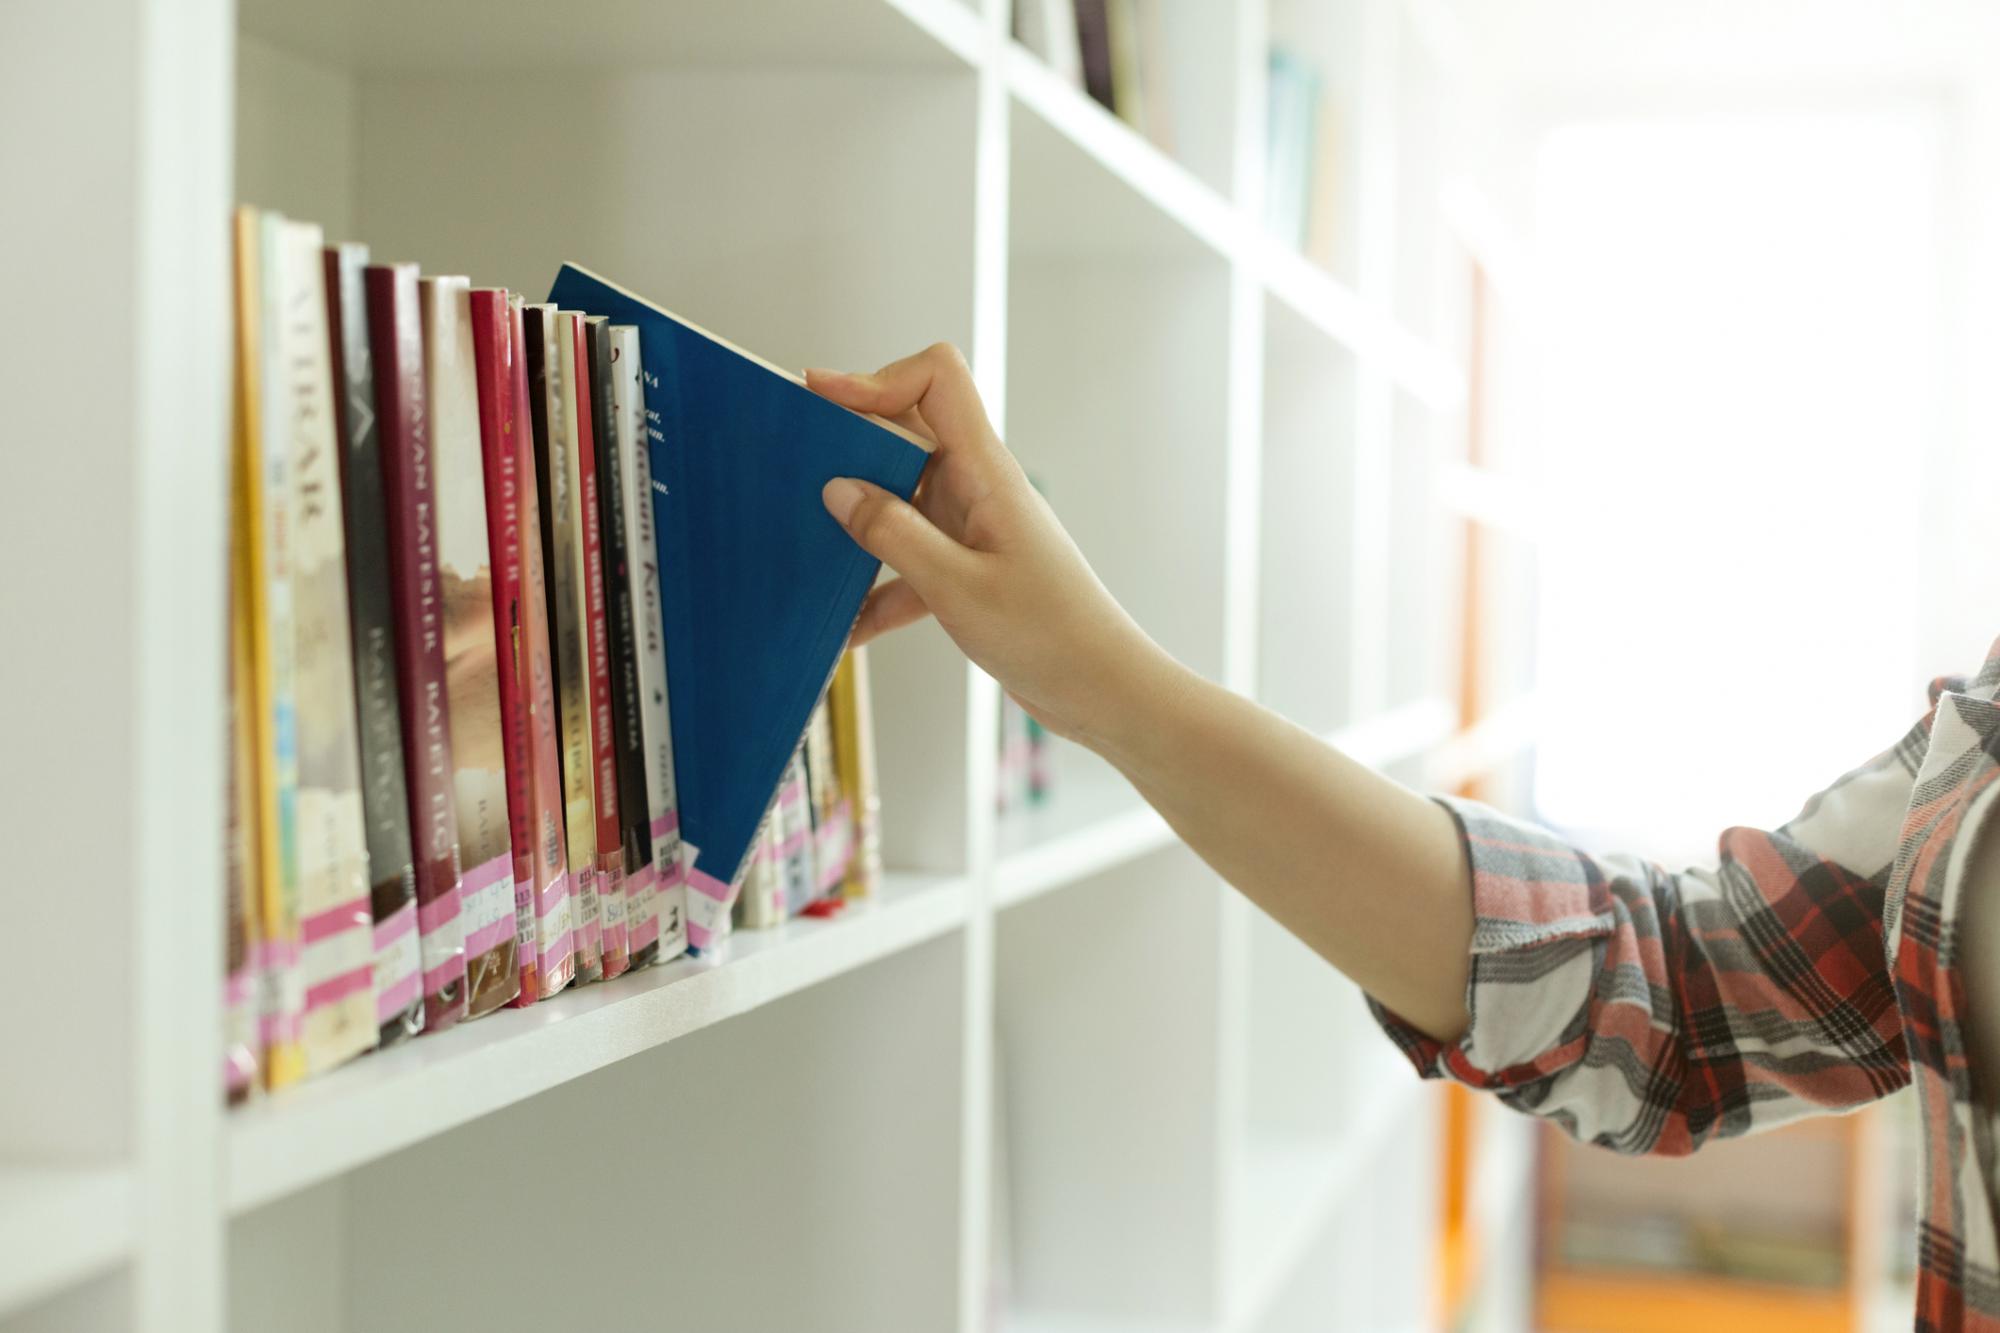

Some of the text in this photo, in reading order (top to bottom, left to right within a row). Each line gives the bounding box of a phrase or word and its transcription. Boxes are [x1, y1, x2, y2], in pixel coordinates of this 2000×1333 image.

[593, 617, 607, 677] HAYAT
[425, 681, 444, 775] RAFET
[598, 704, 611, 750] EROL
